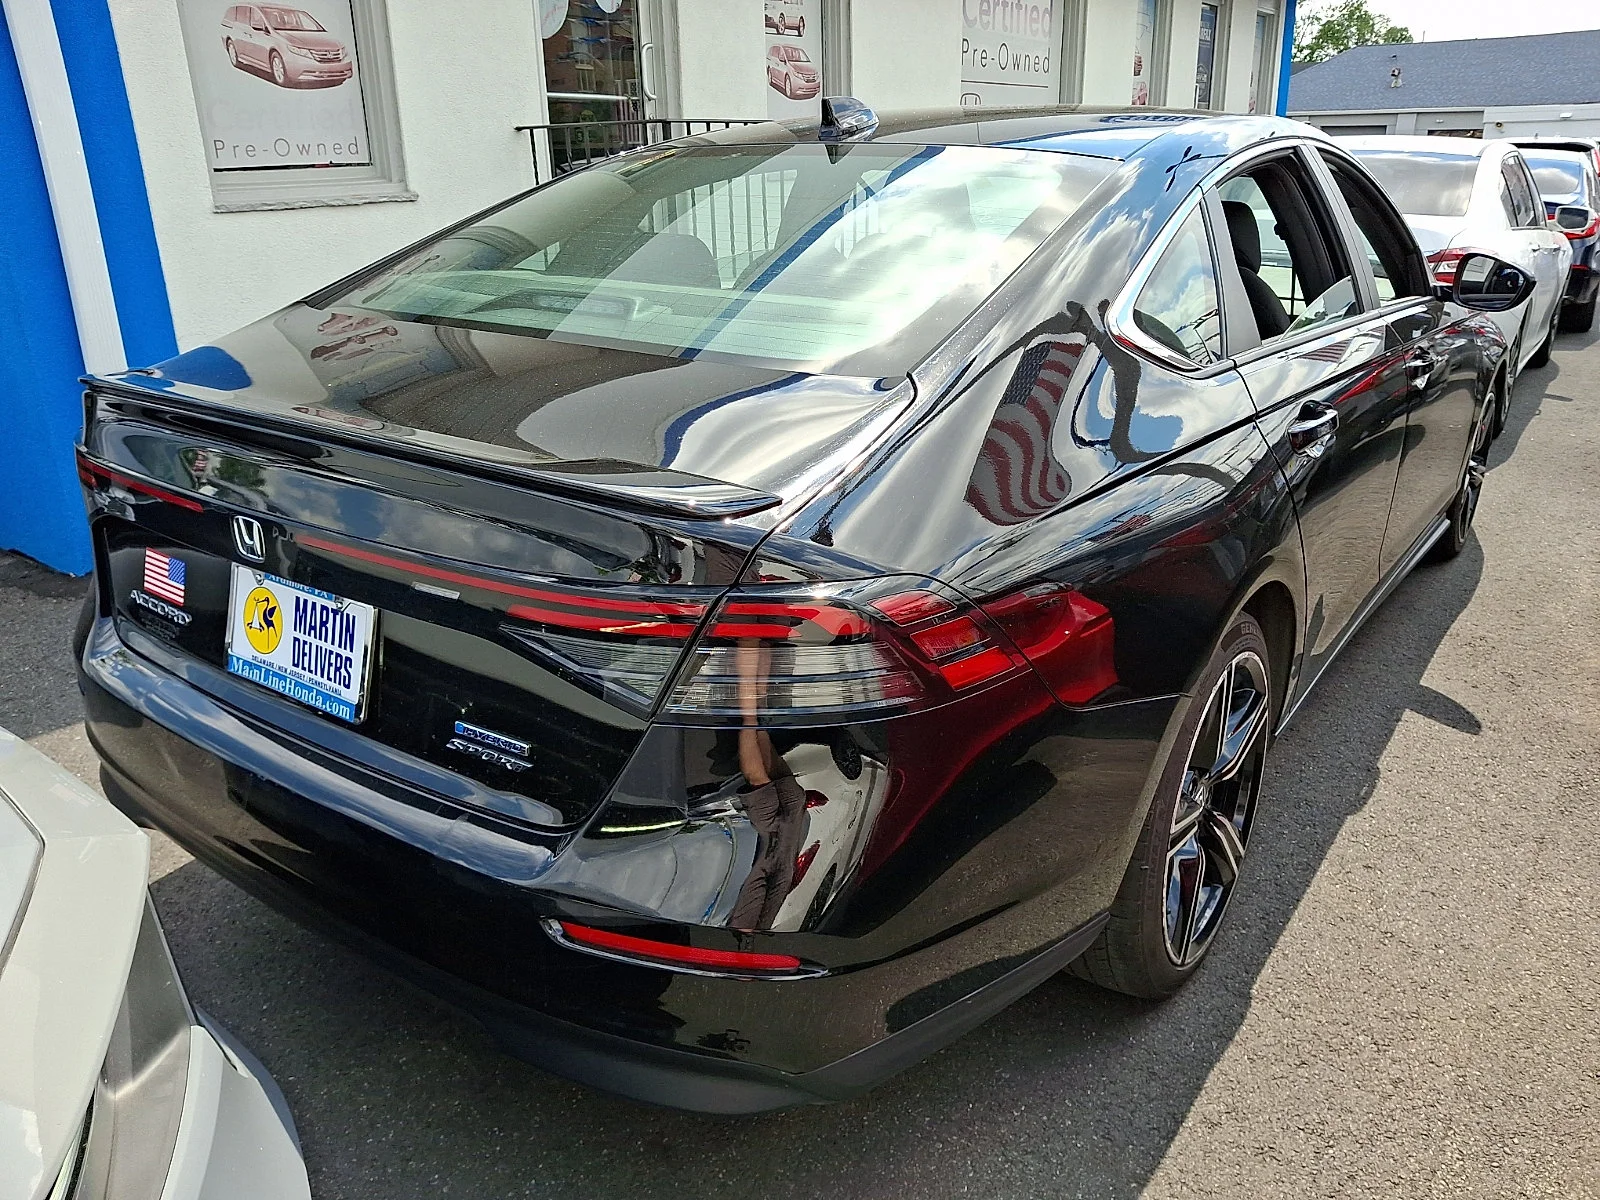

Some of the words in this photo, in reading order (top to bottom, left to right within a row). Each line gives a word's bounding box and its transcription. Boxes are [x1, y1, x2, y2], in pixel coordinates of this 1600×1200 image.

[962, 38, 1051, 74] Pre-Owned
[213, 136, 360, 159] Pre-Owned
[130, 590, 193, 626] ACCORD
[293, 595, 356, 653] MARTIN
[291, 636, 353, 690] DELIVERS
[231, 656, 350, 720] MainLineHonda.com
[446, 738, 534, 773] SPORT
[463, 726, 529, 756] HYBRID
